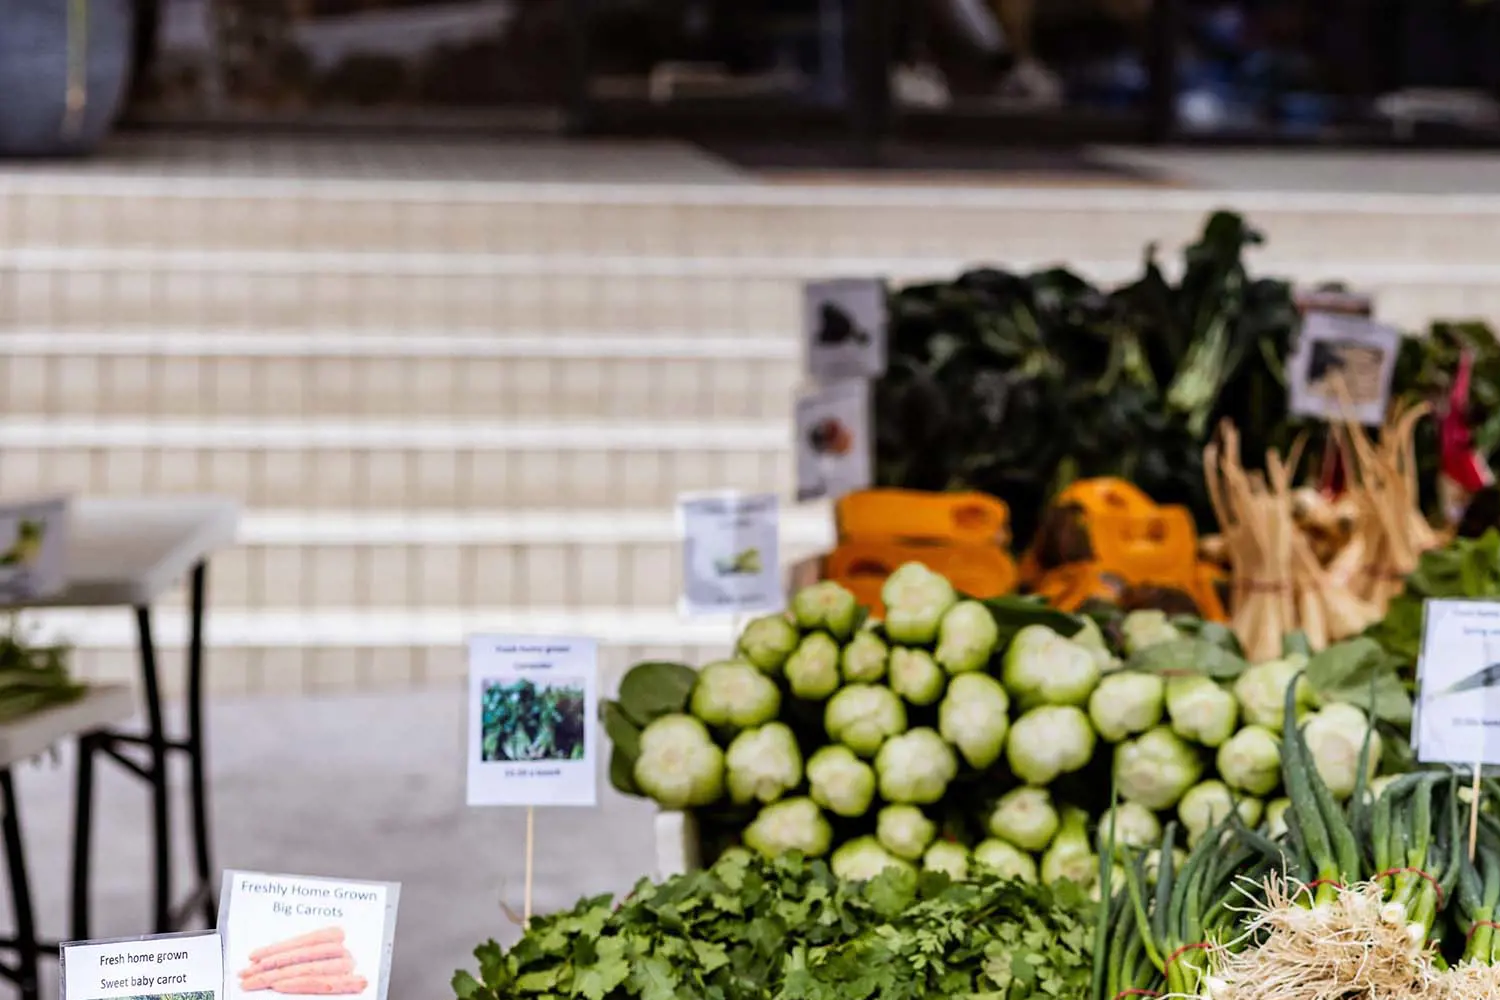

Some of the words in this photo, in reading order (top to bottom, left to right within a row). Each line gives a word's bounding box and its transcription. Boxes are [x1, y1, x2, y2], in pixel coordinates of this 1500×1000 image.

[241, 880, 288, 896] Freshly
[292, 886, 331, 898] Home
[334, 888, 378, 901] Grown
[272, 901, 292, 915] Big
[296, 903, 344, 918] Carrots
[100, 954, 125, 966] Fresh
[127, 952, 154, 964] home
[157, 951, 189, 963] grown
[100, 978, 128, 989] Sweet
[131, 976, 154, 988] baby
[157, 974, 187, 985] carrot
